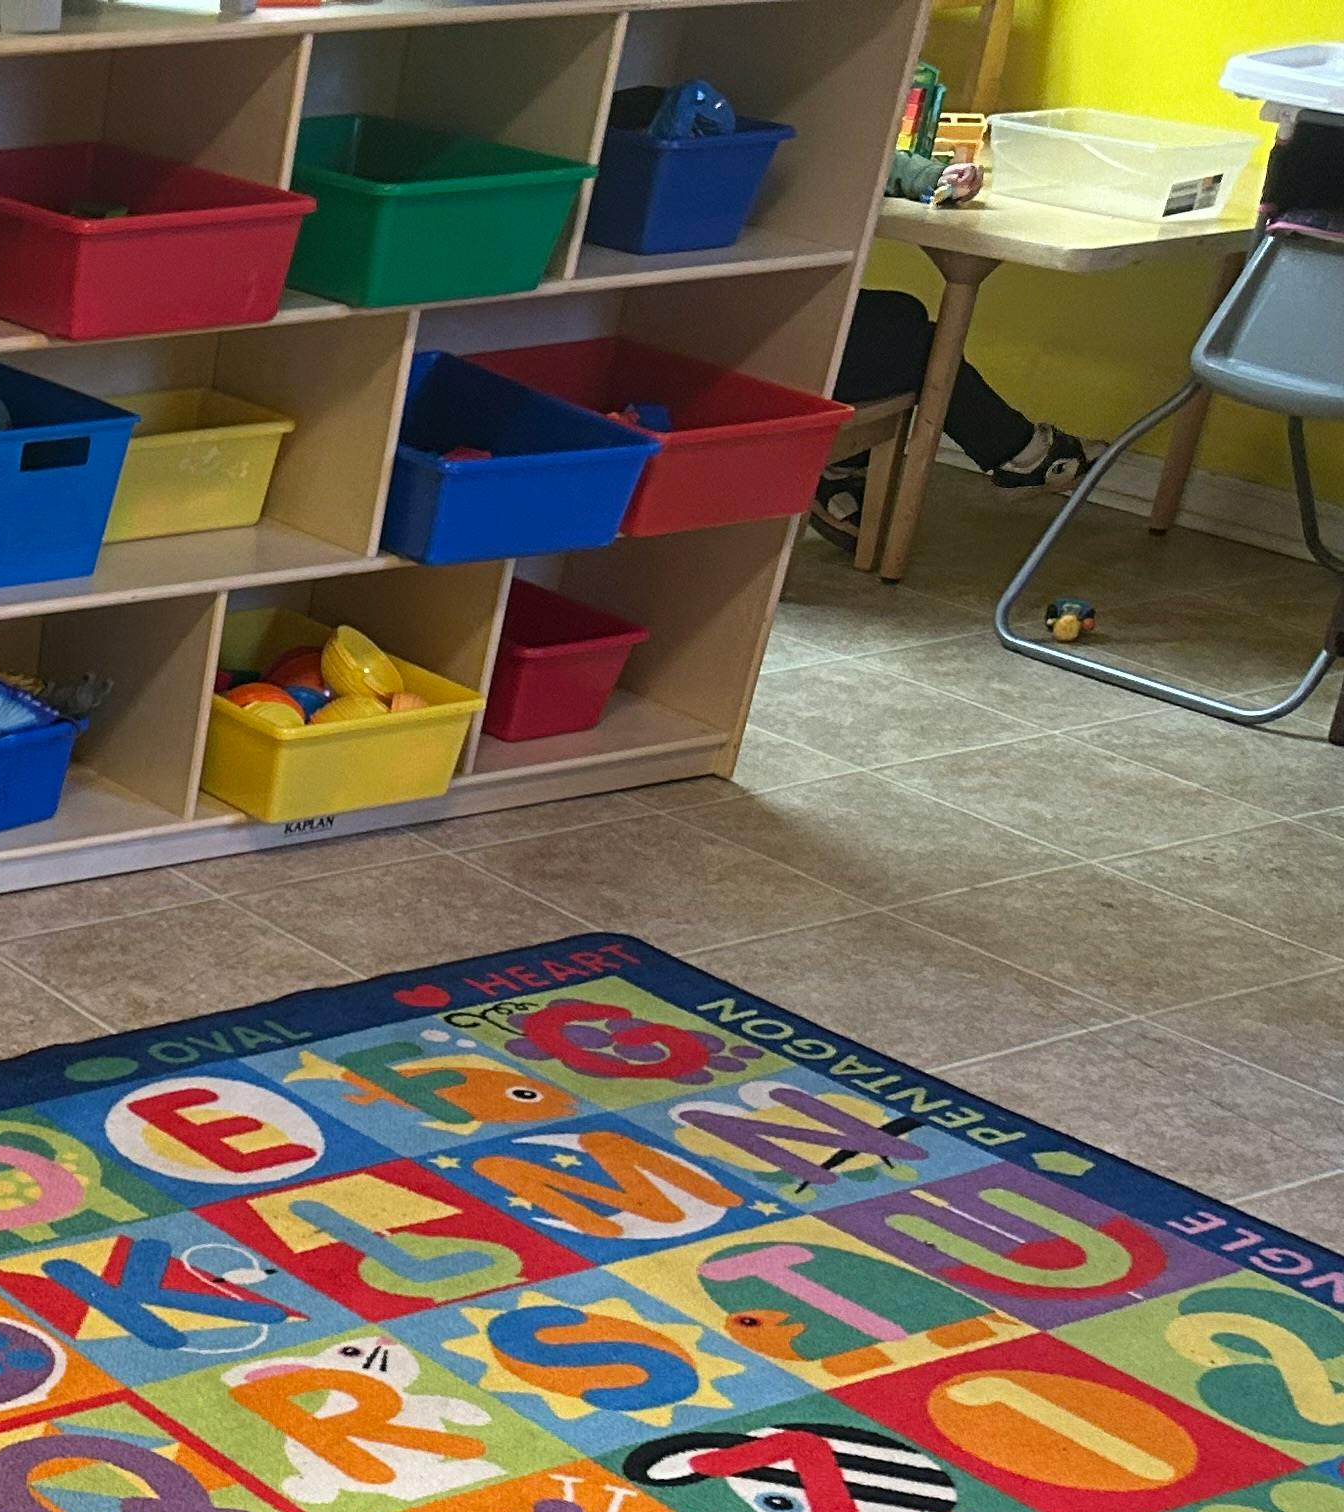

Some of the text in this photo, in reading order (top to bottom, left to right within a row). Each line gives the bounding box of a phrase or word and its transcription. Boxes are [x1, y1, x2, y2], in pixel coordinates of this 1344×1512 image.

[284, 815, 334, 834] KAPLAN
[146, 1018, 312, 1064] OVAL
[463, 943, 643, 997] HEART
[126, 1088, 317, 1173] E
[335, 1041, 478, 1125] F
[522, 1001, 710, 1079] G
[696, 997, 1027, 1147] PENTAGON
[40, 1238, 288, 1349] K
[290, 1199, 497, 1283] L
[471, 1132, 743, 1238] M
[678, 1087, 929, 1185] N
[229, 1367, 487, 1485] R
[486, 1304, 699, 1411] S
[696, 1244, 912, 1343] T
[883, 1187, 1132, 1288] U
[946, 1377, 1175, 1480] 1
[1165, 1312, 1344, 1425] 2
